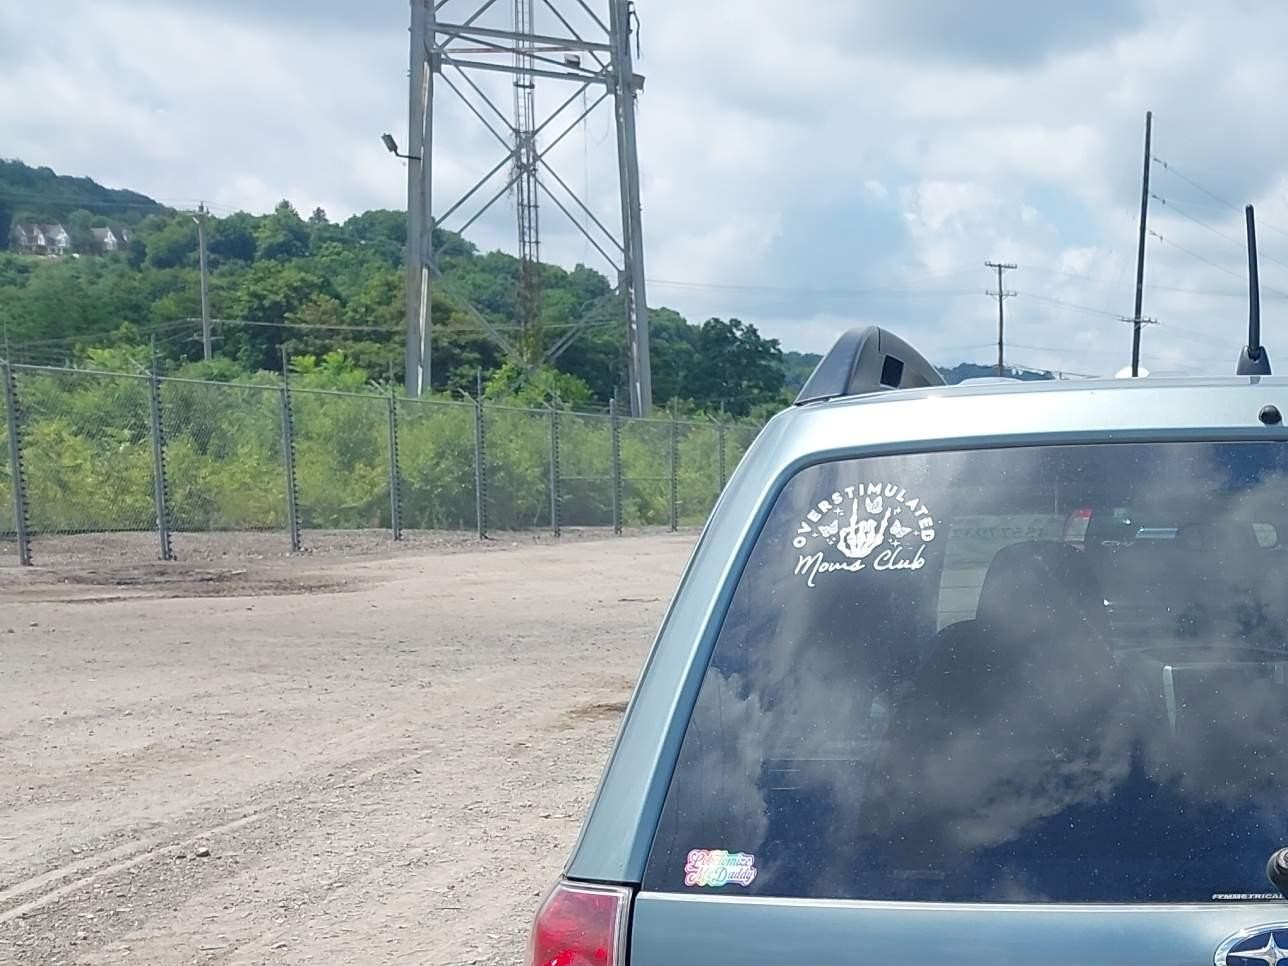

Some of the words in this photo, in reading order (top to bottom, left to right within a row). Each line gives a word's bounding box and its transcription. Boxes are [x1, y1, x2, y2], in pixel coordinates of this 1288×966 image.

[793, 483, 935, 548] OVERSTIMULATED
[794, 552, 865, 587] Moms
[874, 544, 926, 570] Club
[711, 866, 754, 883] Daddy
